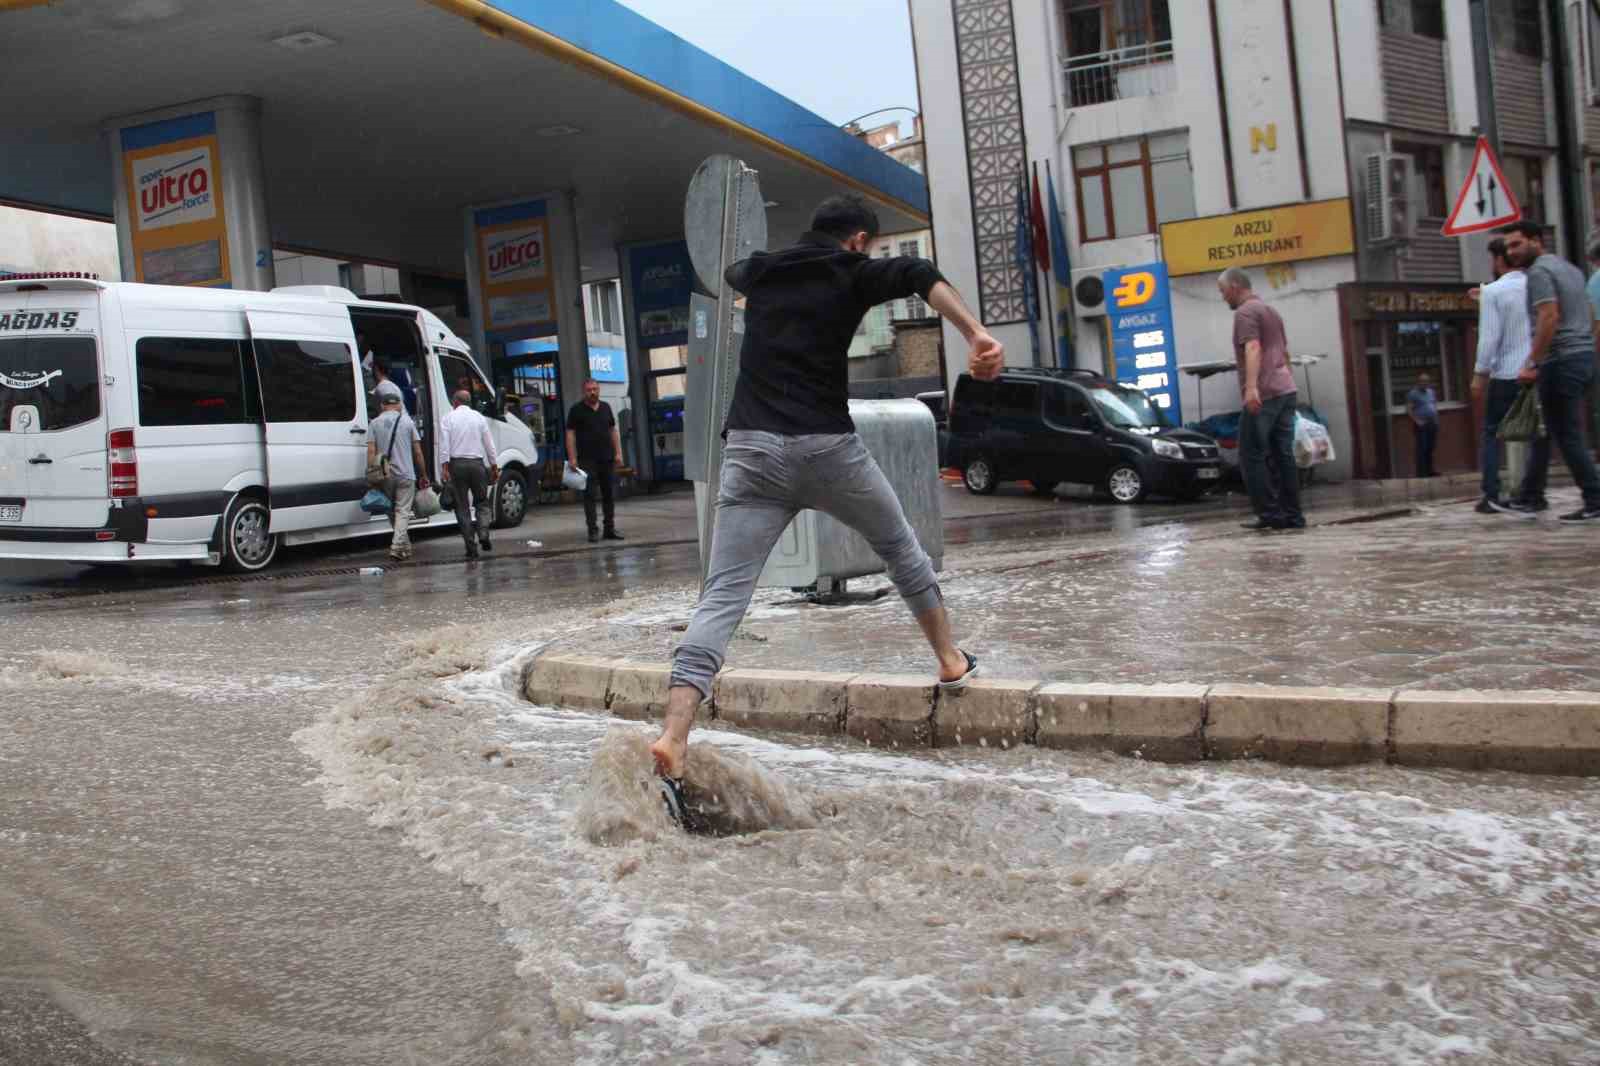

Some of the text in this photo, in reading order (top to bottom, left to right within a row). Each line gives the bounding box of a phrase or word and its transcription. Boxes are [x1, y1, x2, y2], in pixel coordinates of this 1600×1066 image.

[142, 168, 208, 213] ultra
[1233, 221, 1272, 237] ARZU
[489, 241, 541, 271] ultra
[1208, 235, 1302, 261] RESTAURANT
